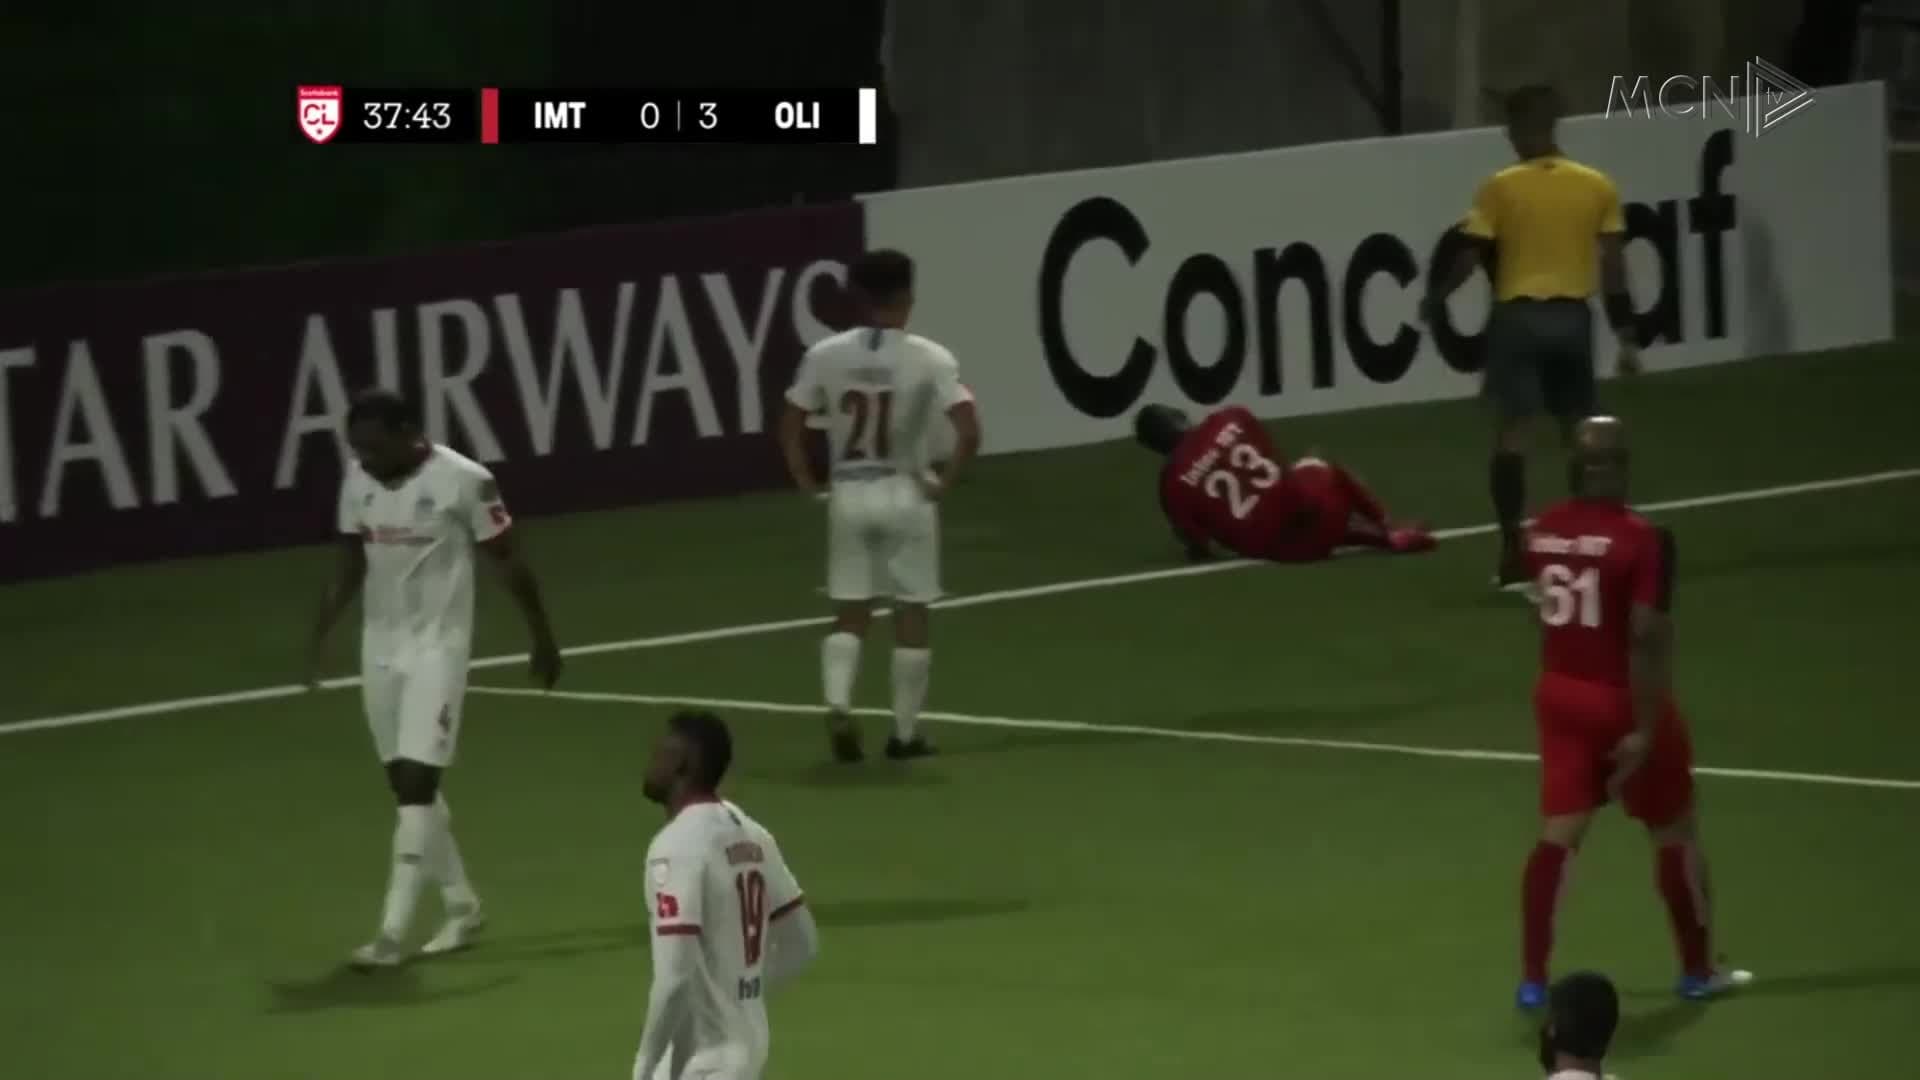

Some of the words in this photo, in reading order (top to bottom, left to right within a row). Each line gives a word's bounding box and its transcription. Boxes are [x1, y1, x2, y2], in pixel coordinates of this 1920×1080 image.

[840, 390, 893, 459] 21
[1205, 443, 1281, 520] 23
[1539, 563, 1601, 628] 61
[735, 870, 765, 968] 19
